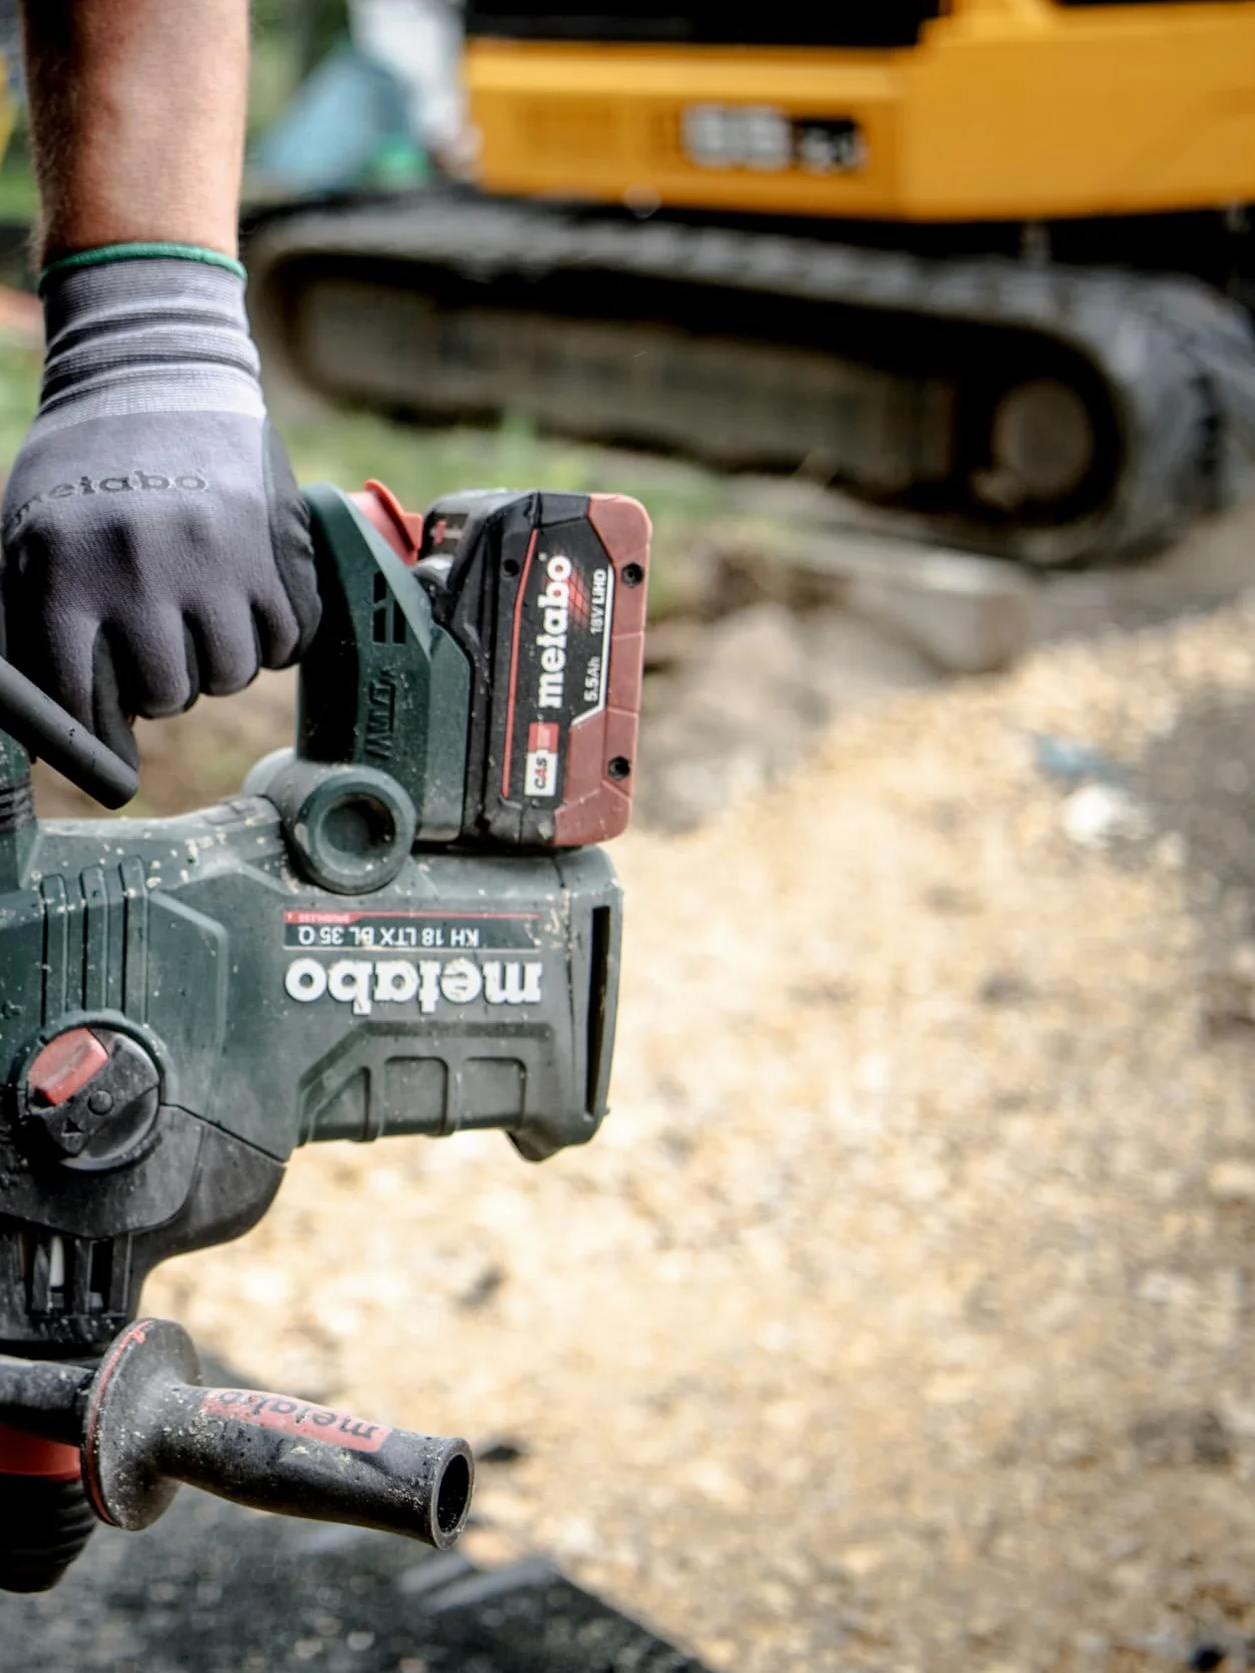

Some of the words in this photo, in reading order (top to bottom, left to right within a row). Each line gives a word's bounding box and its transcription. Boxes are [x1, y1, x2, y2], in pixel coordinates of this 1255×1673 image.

[537, 555, 573, 709] metabo
[534, 757, 548, 790] CAS
[297, 926, 316, 946] Q
[319, 927, 344, 945] 35
[380, 928, 417, 946] LTX
[421, 928, 445, 946] 18
[450, 927, 480, 946] KH
[284, 957, 543, 1015] metabo
